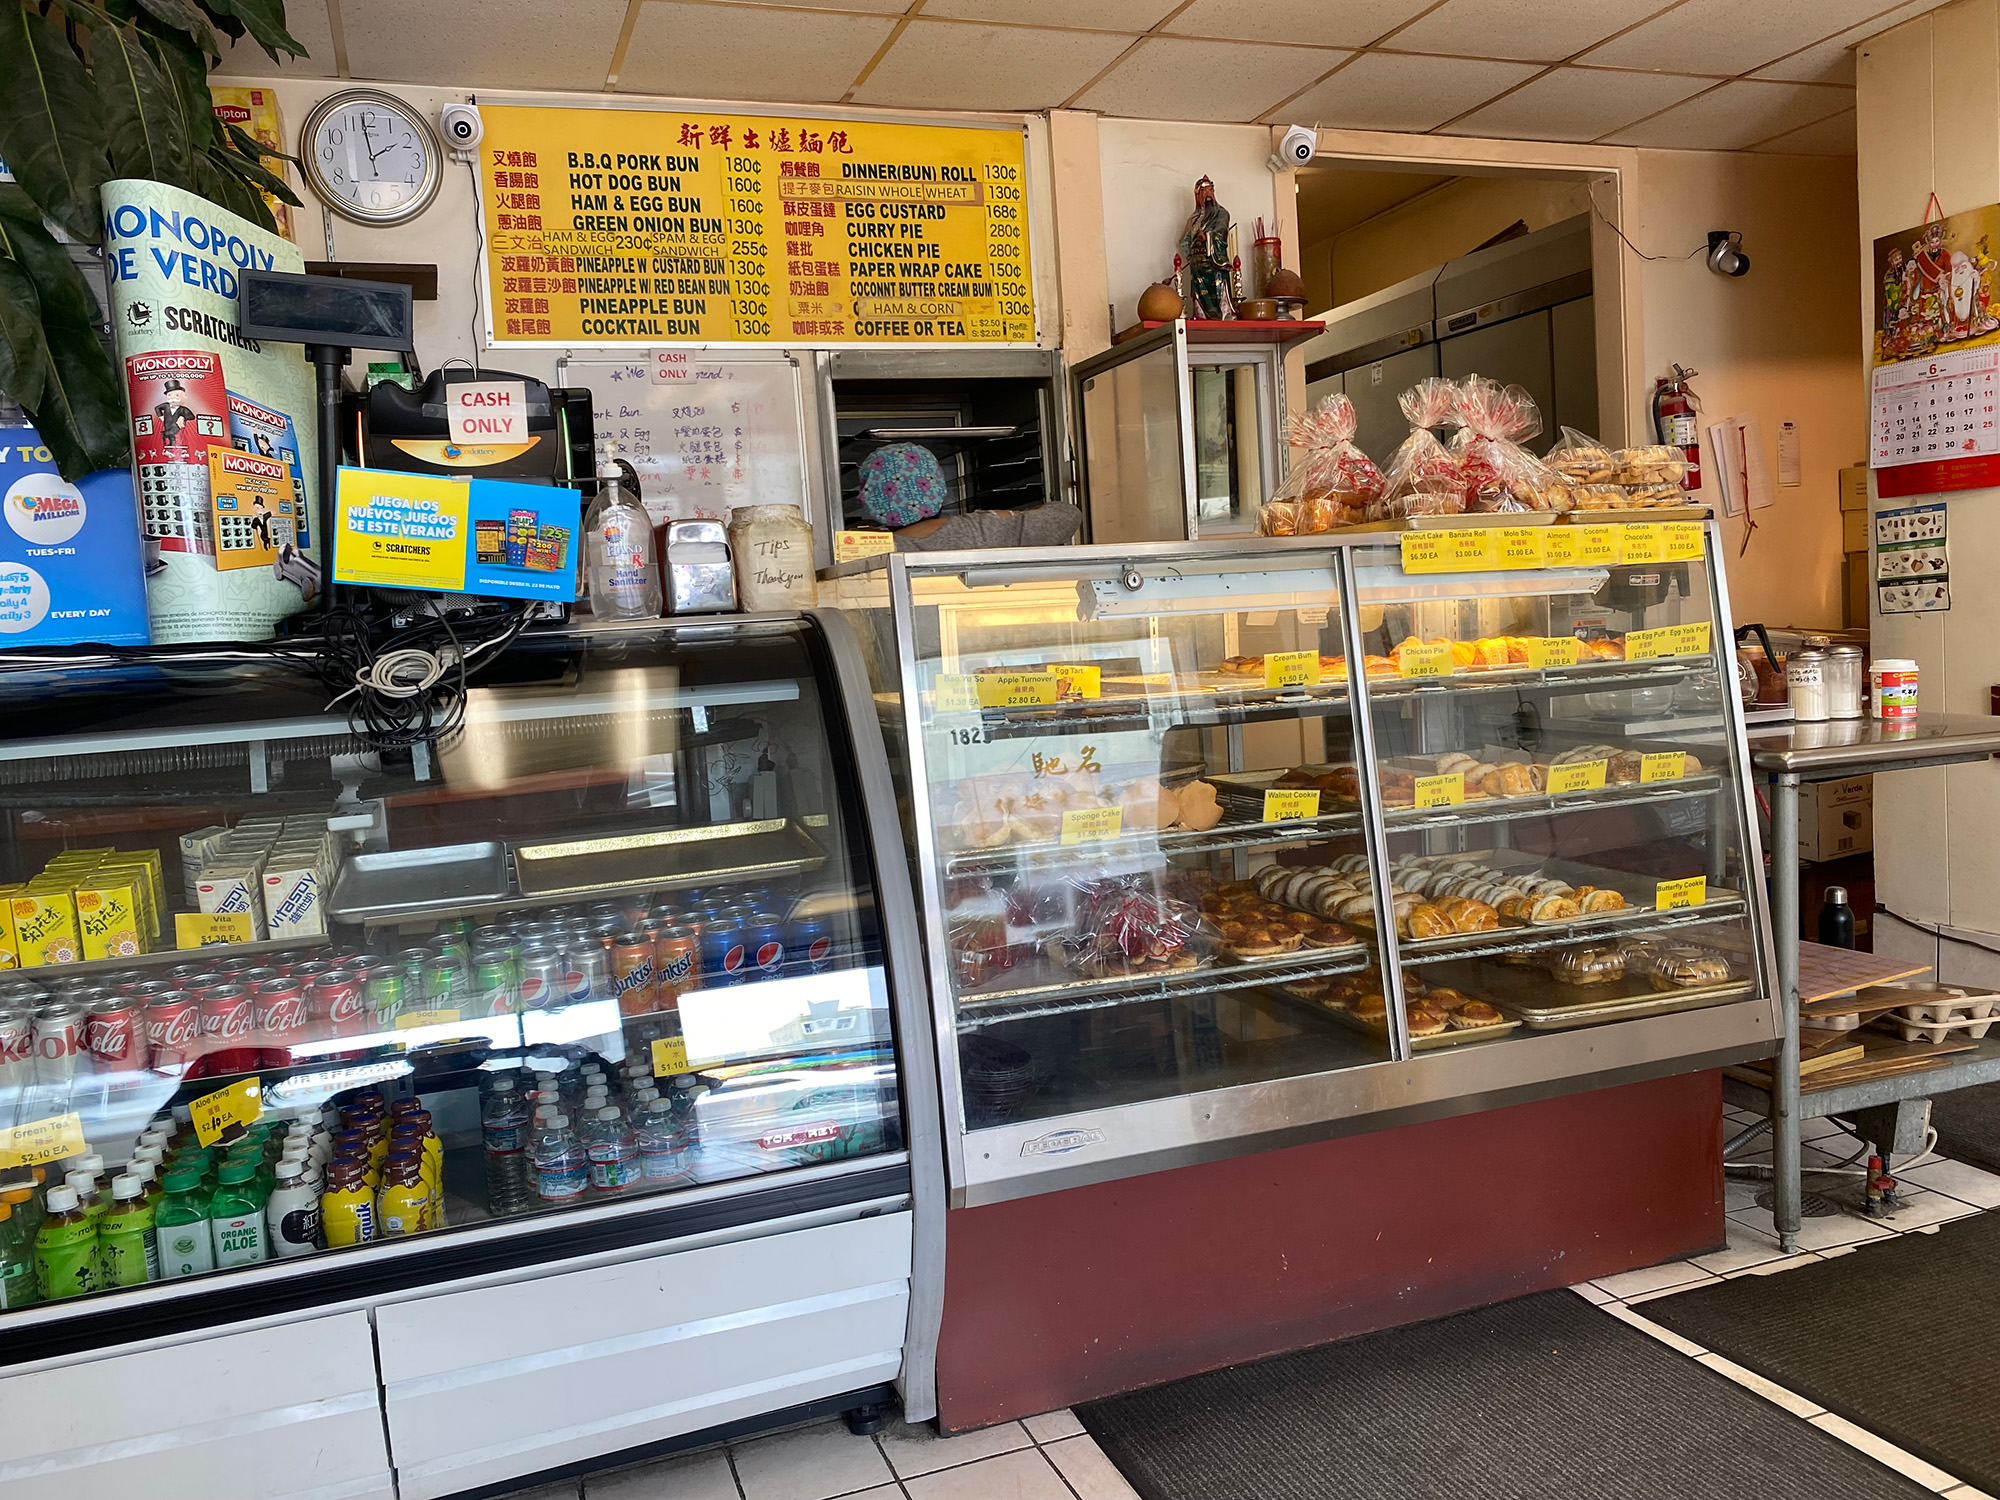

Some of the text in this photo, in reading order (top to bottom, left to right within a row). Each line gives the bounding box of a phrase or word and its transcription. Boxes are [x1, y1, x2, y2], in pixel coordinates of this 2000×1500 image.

[214, 108, 248, 121] Lipton
[328, 128, 344, 146] 10
[402, 132, 412, 149] 2
[568, 152, 699, 172] B.B.Q PORK BUN
[726, 157, 762, 175] 180¢
[842, 163, 977, 182] DINNER(BUN) ROLL
[985, 165, 1017, 182] 130¢
[569, 173, 681, 192] HOT DOG BUN
[727, 177, 762, 195] 160¢
[837, 184, 967, 199] RAISIN WHOLE WHEAT
[988, 186, 1020, 201] 130¢
[571, 194, 701, 213] HAM & EGG BUN
[730, 199, 764, 215] 160¢
[845, 202, 946, 220] EGG CUSTARD
[986, 205, 1018, 220] 168¢
[573, 215, 722, 233] GREEN ONION BUN
[726, 219, 764, 237] 130¢
[847, 222, 923, 239] CURRY PIE
[989, 224, 1021, 239] 280¢
[493, 235, 542, 250] 三文治
[616, 235, 652, 251] 230¢
[652, 233, 726, 244] SPAM & EGG
[544, 245, 613, 255] SANDWICH
[653, 246, 719, 256] SANDWICH
[732, 241, 768, 258] 255¢
[848, 242, 940, 258] CHICKEN PIE
[988, 243, 1020, 259] 280¢
[576, 257, 635, 273] PINEAPPLE
[652, 258, 700, 274] CUSTARD
[703, 259, 725, 274] BUN
[729, 260, 766, 277] 130¢
[850, 262, 983, 278] PAPER WRAP CAKE
[989, 263, 1022, 279] 150¢
[735, 280, 771, 297] 130¢
[994, 282, 1027, 298] 150¢
[580, 298, 706, 315] PINEAPPLE BUN
[731, 300, 767, 317] 130¢
[874, 303, 954, 315] HAM & CORN
[998, 301, 1031, 317] 130¢
[582, 319, 700, 335] COCKTAIL BUN
[734, 320, 771, 337] 130¢
[854, 321, 965, 336] COFFEE OR TEA
[136, 357, 210, 372] MONOPOLY
[658, 353, 687, 363] CASH
[659, 369, 688, 379] ONLY
[1928, 363, 1937, 375] 6
[460, 392, 511, 407] CASH
[231, 400, 284, 428] MONOPOLY
[462, 418, 513, 434] ONLY
[226, 457, 282, 478] MONOPOLY
[36, 496, 79, 514] MEGA
[368, 495, 440, 512] JUEGA LOS
[33, 509, 80, 522] MILLIONS
[347, 506, 458, 526] NUEVOS JUEGOS
[347, 519, 457, 539] DE ESTE VERANO
[546, 528, 563, 539] 25
[1403, 532, 1443, 541] Walnut Cake
[1449, 531, 1472, 539] Banana
[1624, 533, 1653, 541] Chocolate
[385, 543, 431, 556] SCRATCHERS
[616, 569, 638, 577] Hand
[608, 577, 647, 586] Sanitizer
[51, 609, 110, 619] EVERY DAY
[1406, 647, 1432, 655] Chicken
[1542, 639, 1559, 647] Curry
[1273, 654, 1296, 662] Cream
[1055, 667, 1068, 675] Egg
[1278, 675, 1297, 683] $1.50
[998, 675, 1052, 684] Apple Turnover
[1007, 696, 1041, 704] $2.80 EA
[1553, 760, 1604, 773] Wintermelon Puff
[1416, 779, 1443, 788] Coconut
[1842, 783, 1863, 794] Verde
[1071, 812, 1100, 821] Sponge
[1657, 880, 1704, 892] Butterfly Cookie
[614, 956, 653, 997] Sunkist
[660, 1061, 683, 1072] $1.10
[195, 1088, 230, 1110] Aloe King
[13, 1121, 69, 1139] Green Tea
[1028, 1131, 1098, 1152] FEDERAL
[21, 1145, 69, 1163] $2.10 EA
[220, 1226, 257, 1239] ORGANIC
[223, 1235, 258, 1252] ALOE
